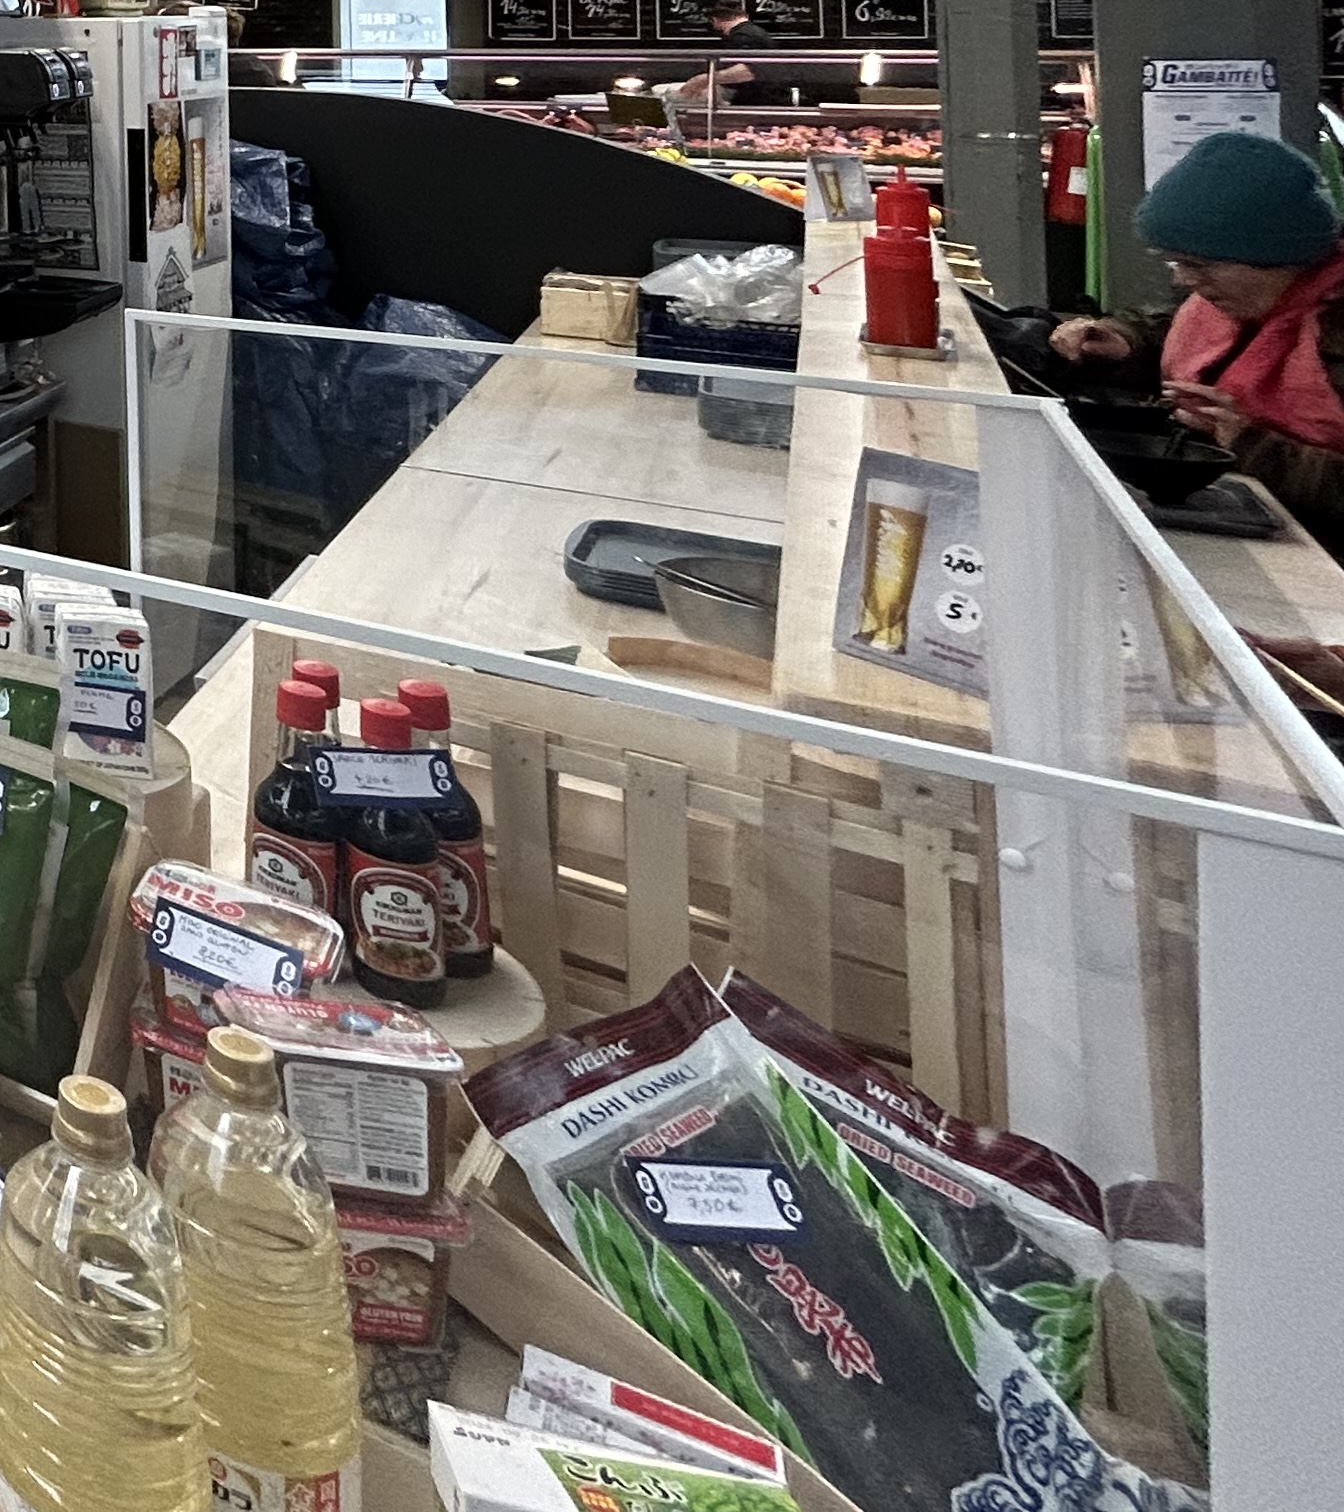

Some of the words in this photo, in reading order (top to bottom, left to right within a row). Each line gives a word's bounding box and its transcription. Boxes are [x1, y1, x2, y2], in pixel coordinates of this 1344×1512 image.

[73, 648, 140, 674] TOFU
[146, 873, 246, 919] MISO
[372, 908, 426, 927] TERIYAKI
[564, 1037, 635, 1078] WELPAC
[561, 1096, 626, 1138] DASHI
[626, 1063, 700, 1105] KOMBU
[803, 1076, 892, 1130] DASHI
[621, 1132, 666, 1158] DRIED
[660, 1104, 717, 1148] SEAWEED
[838, 1123, 892, 1164] DRIED
[893, 1152, 977, 1208] SEAWEED
